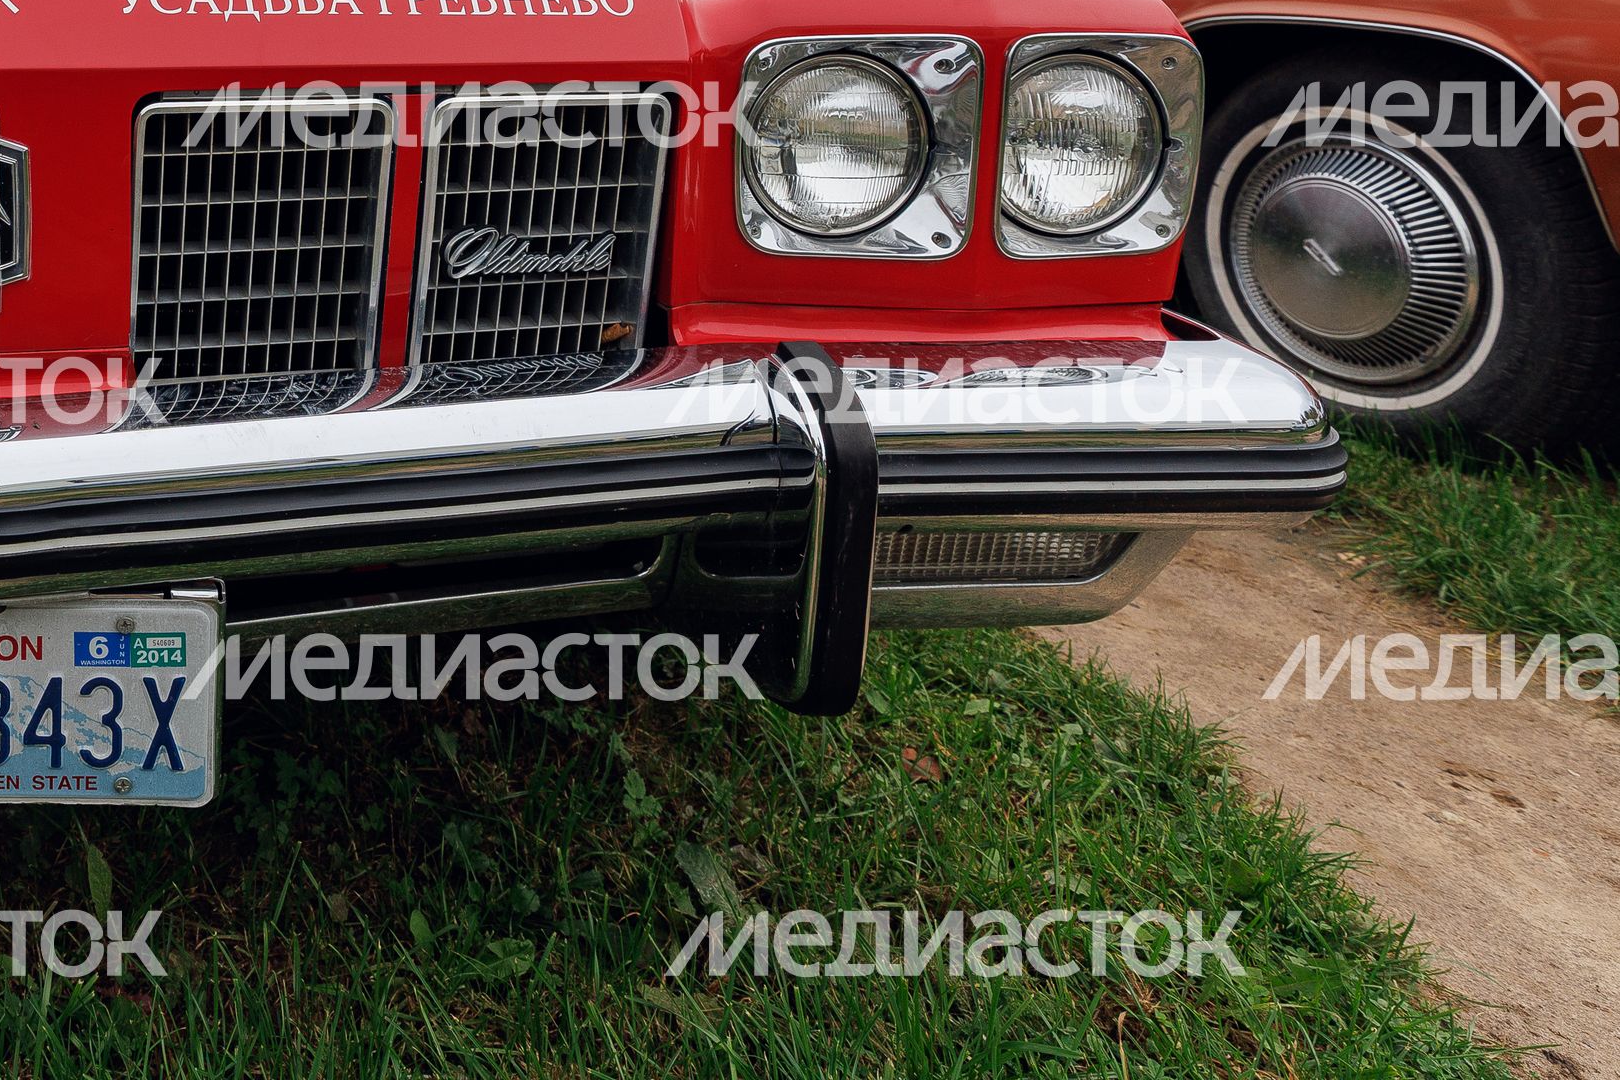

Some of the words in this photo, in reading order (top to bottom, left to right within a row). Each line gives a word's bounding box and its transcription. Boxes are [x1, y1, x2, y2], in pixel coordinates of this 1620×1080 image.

[88, 635, 109, 659] 6
[133, 638, 144, 649] A
[136, 649, 183, 664] 2014
[31, 774, 98, 791] STATE
